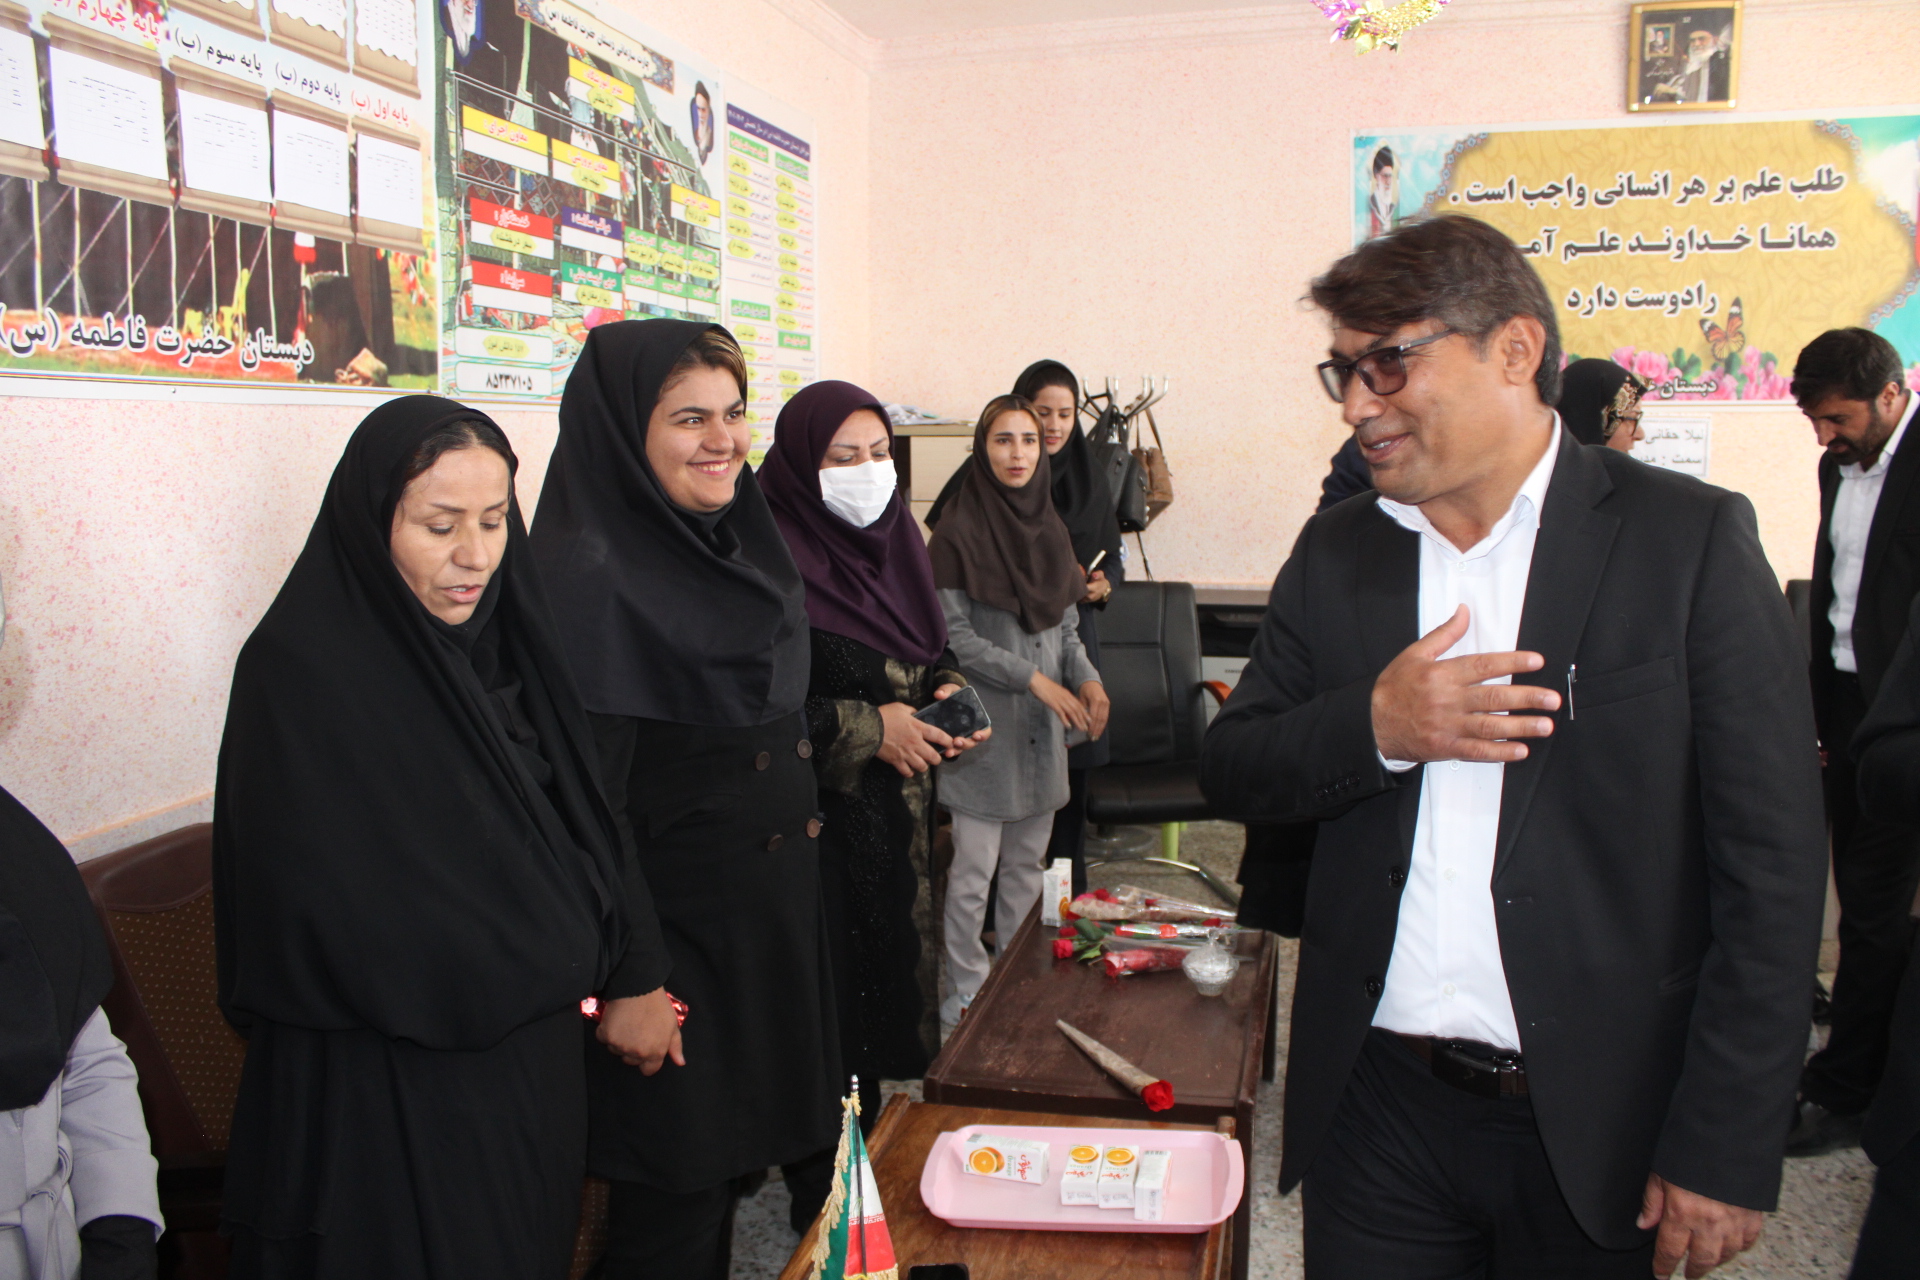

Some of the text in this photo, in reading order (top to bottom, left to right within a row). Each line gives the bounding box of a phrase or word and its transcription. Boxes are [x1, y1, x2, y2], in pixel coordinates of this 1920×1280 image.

[77, 0, 161, 43] پایه چهارم
[174, 27, 264, 78] پایه سوم (ب)
[275, 61, 342, 105] پایه دوم (ب)
[351, 89, 410, 127] پایه اول (ب)
[1466, 177, 1515, 202] است
[1521, 175, 1587, 207] واجب
[1594, 172, 1669, 206] انسانی
[1675, 177, 1706, 204] هر
[1712, 178, 1736, 203] بر
[1742, 169, 1783, 202] علم
[1789, 166, 1845, 199] طلب
[1563, 229, 1621, 261] علم
[1628, 226, 1752, 260] خداوند
[1760, 224, 1837, 250] همانا
[1566, 284, 1619, 316] دارد
[70, 312, 148, 350] فاطمه
[156, 325, 233, 367] حضرت
[242, 329, 314, 373] دبستان
[1660, 376, 1717, 399] دبستان
